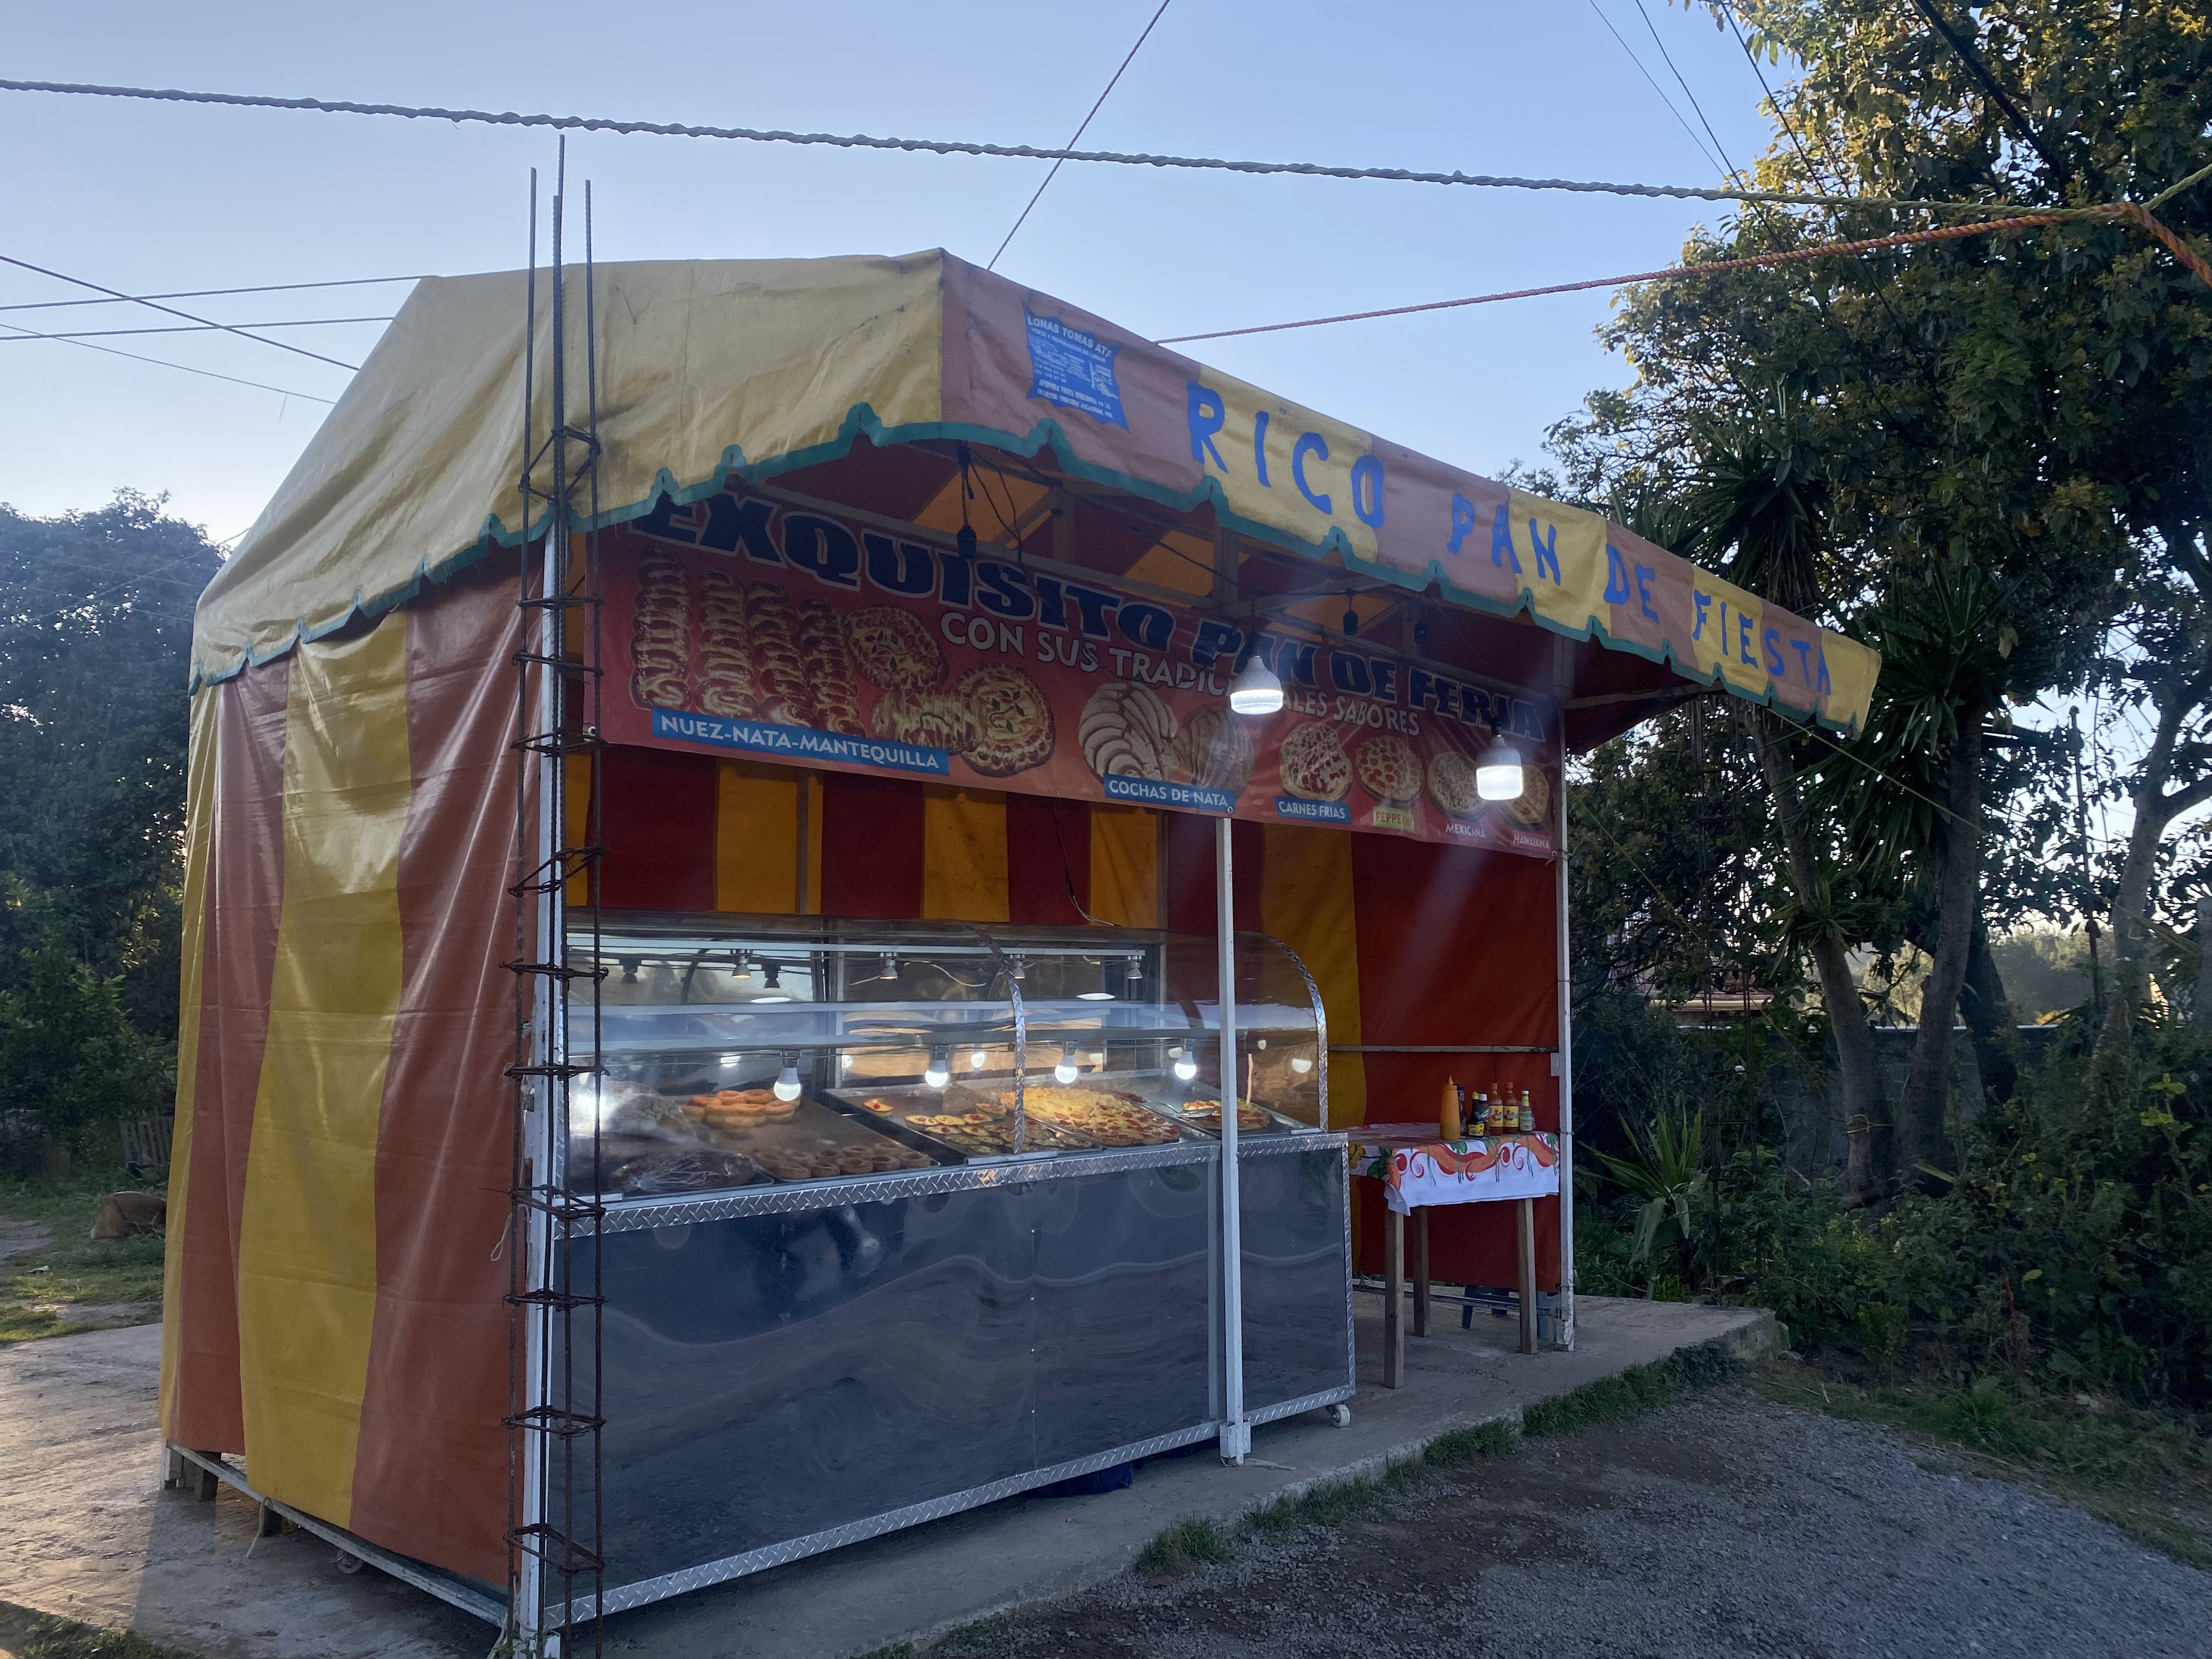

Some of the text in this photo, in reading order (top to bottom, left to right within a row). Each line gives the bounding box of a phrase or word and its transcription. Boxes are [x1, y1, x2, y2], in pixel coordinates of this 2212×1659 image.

[1028, 316, 1059, 333] LONAS
[1062, 327, 1093, 348] TOMAS
[1187, 380, 1832, 696] RICO PAN DE FIESTA
[629, 489, 1546, 743] EXQUISITO PAN DE FERIA
[940, 612, 1420, 736] CON SUS TRADICALES SABORES
[1109, 779, 1228, 807] COCHAS DE NATA
[1278, 800, 1346, 820] CARNES FRIAS
[1445, 822, 1486, 839] MEXICANA
[1513, 833, 1550, 849] HAWAIANA
